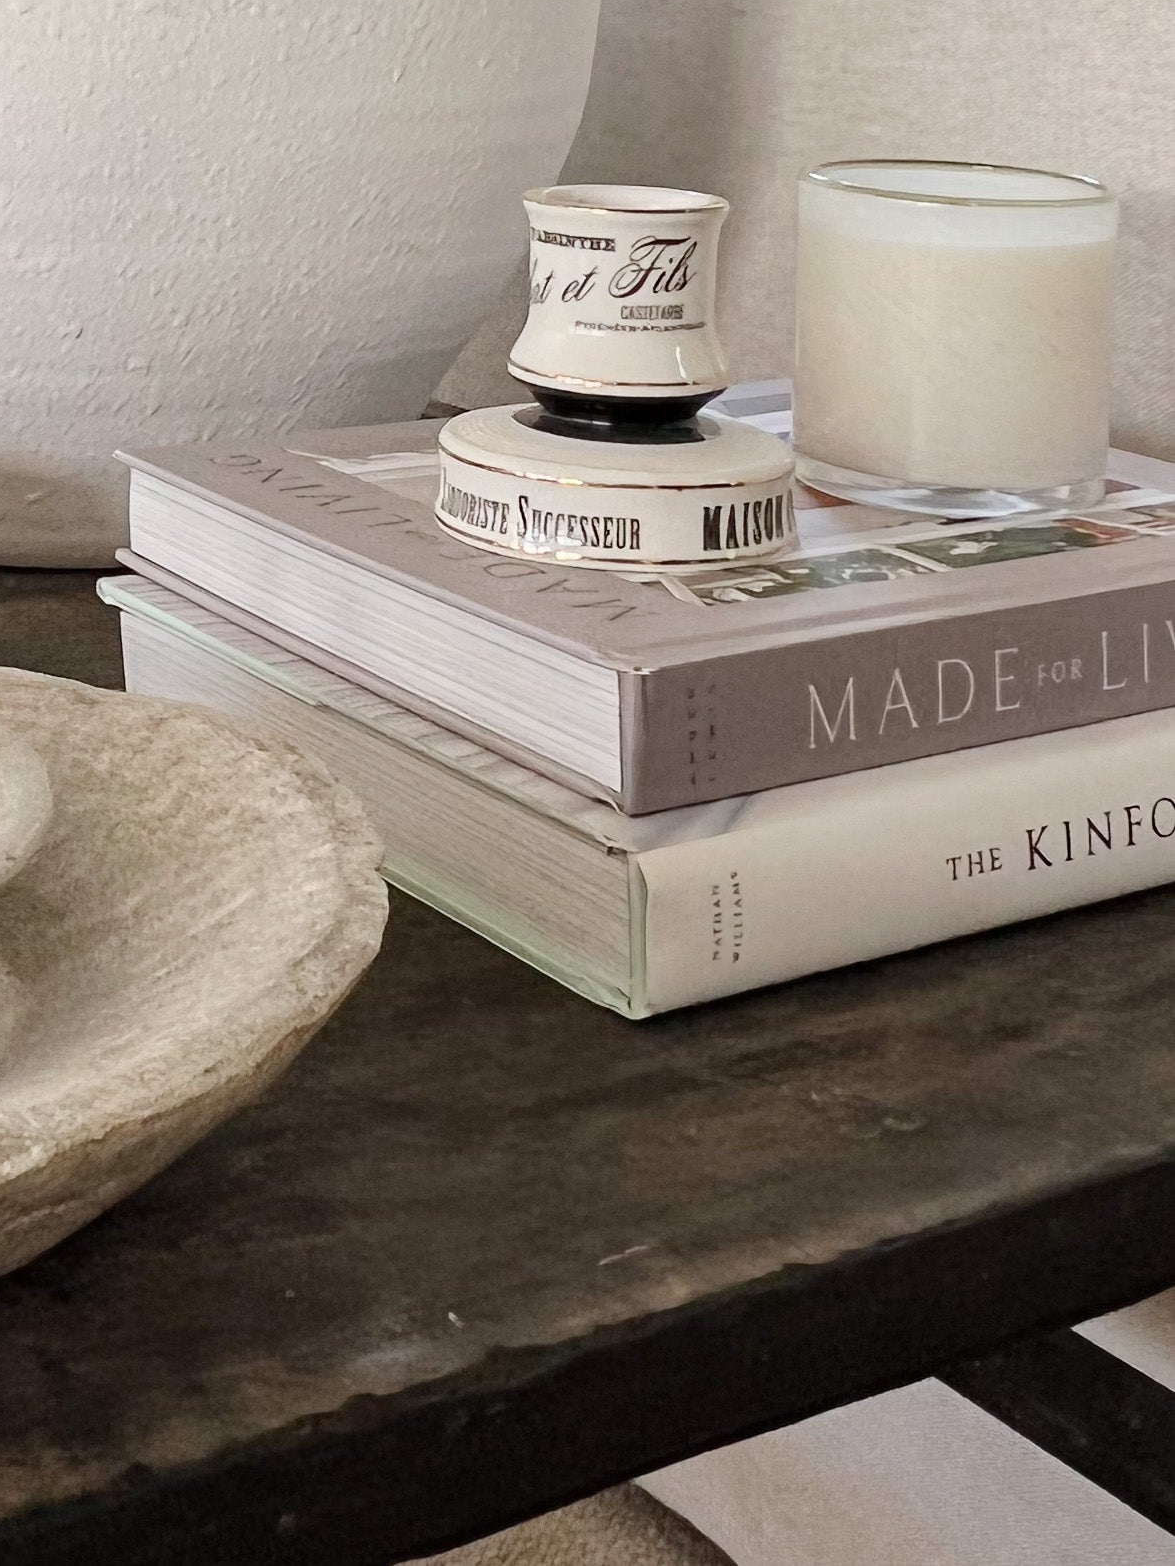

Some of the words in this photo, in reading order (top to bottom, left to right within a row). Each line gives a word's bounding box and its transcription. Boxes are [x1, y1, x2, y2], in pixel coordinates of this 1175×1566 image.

[561, 265, 599, 303] et
[608, 235, 698, 299] Fils
[517, 495, 642, 550] SUCCESSEUR
[703, 494, 784, 551] MAISON
[807, 647, 1021, 750] MADE
[1037, 658, 1083, 686] FOR
[945, 847, 1003, 881] THE
[1025, 797, 1175, 871] KINFO
